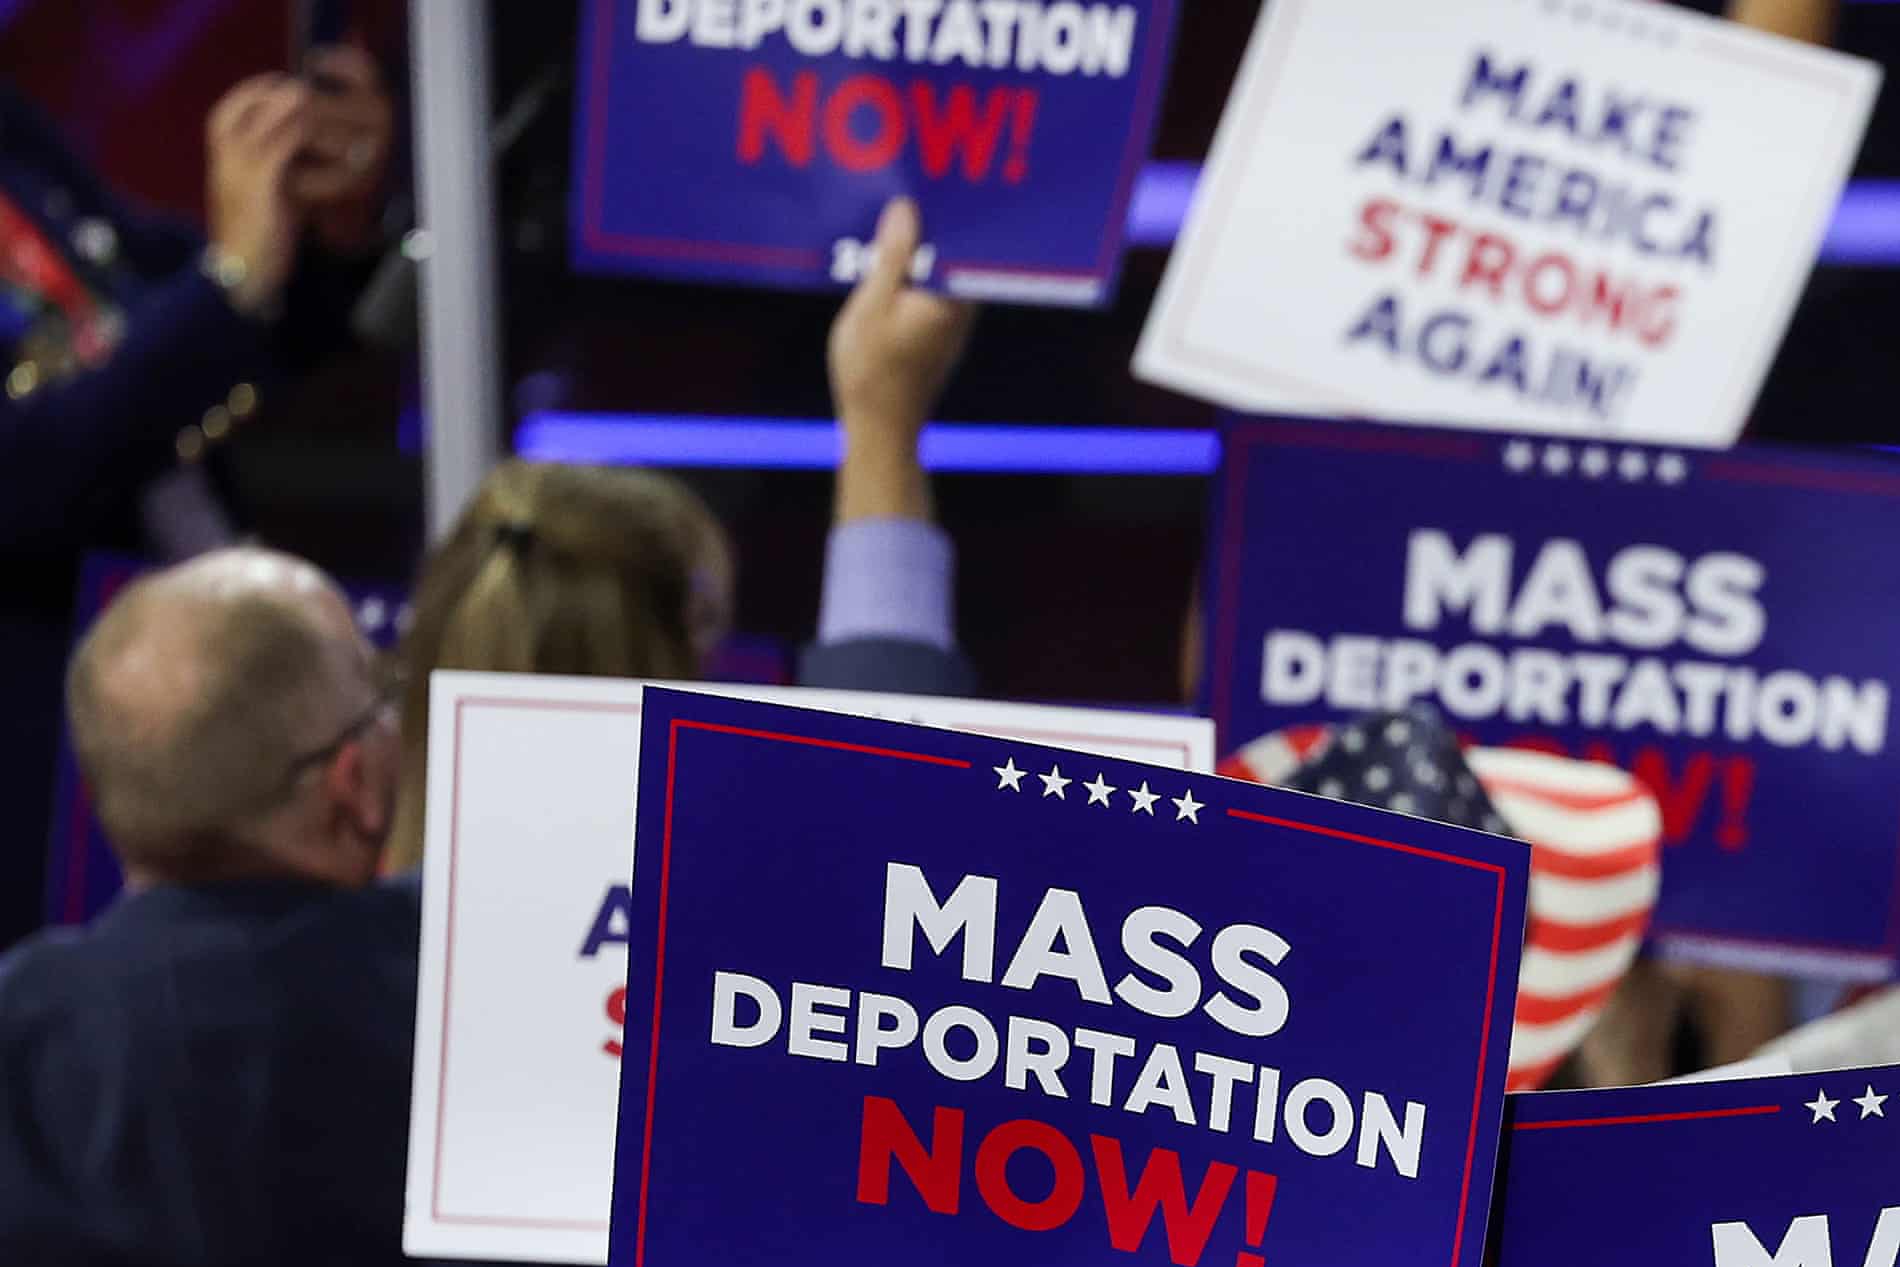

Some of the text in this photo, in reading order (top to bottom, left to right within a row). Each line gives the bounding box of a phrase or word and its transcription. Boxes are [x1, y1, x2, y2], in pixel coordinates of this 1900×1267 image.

[635, 0, 1137, 77] DEPORTATION
[737, 65, 1037, 184] NOW!
[1458, 50, 1694, 172] MAKE
[1353, 113, 1716, 270] AMERICA
[1346, 196, 1682, 349] STRONG
[1403, 527, 1767, 657] MASS
[1259, 629, 1890, 756] DEPORTATION
[881, 862, 1290, 1037] MASS
[711, 971, 1426, 1179] DEPORTATION
